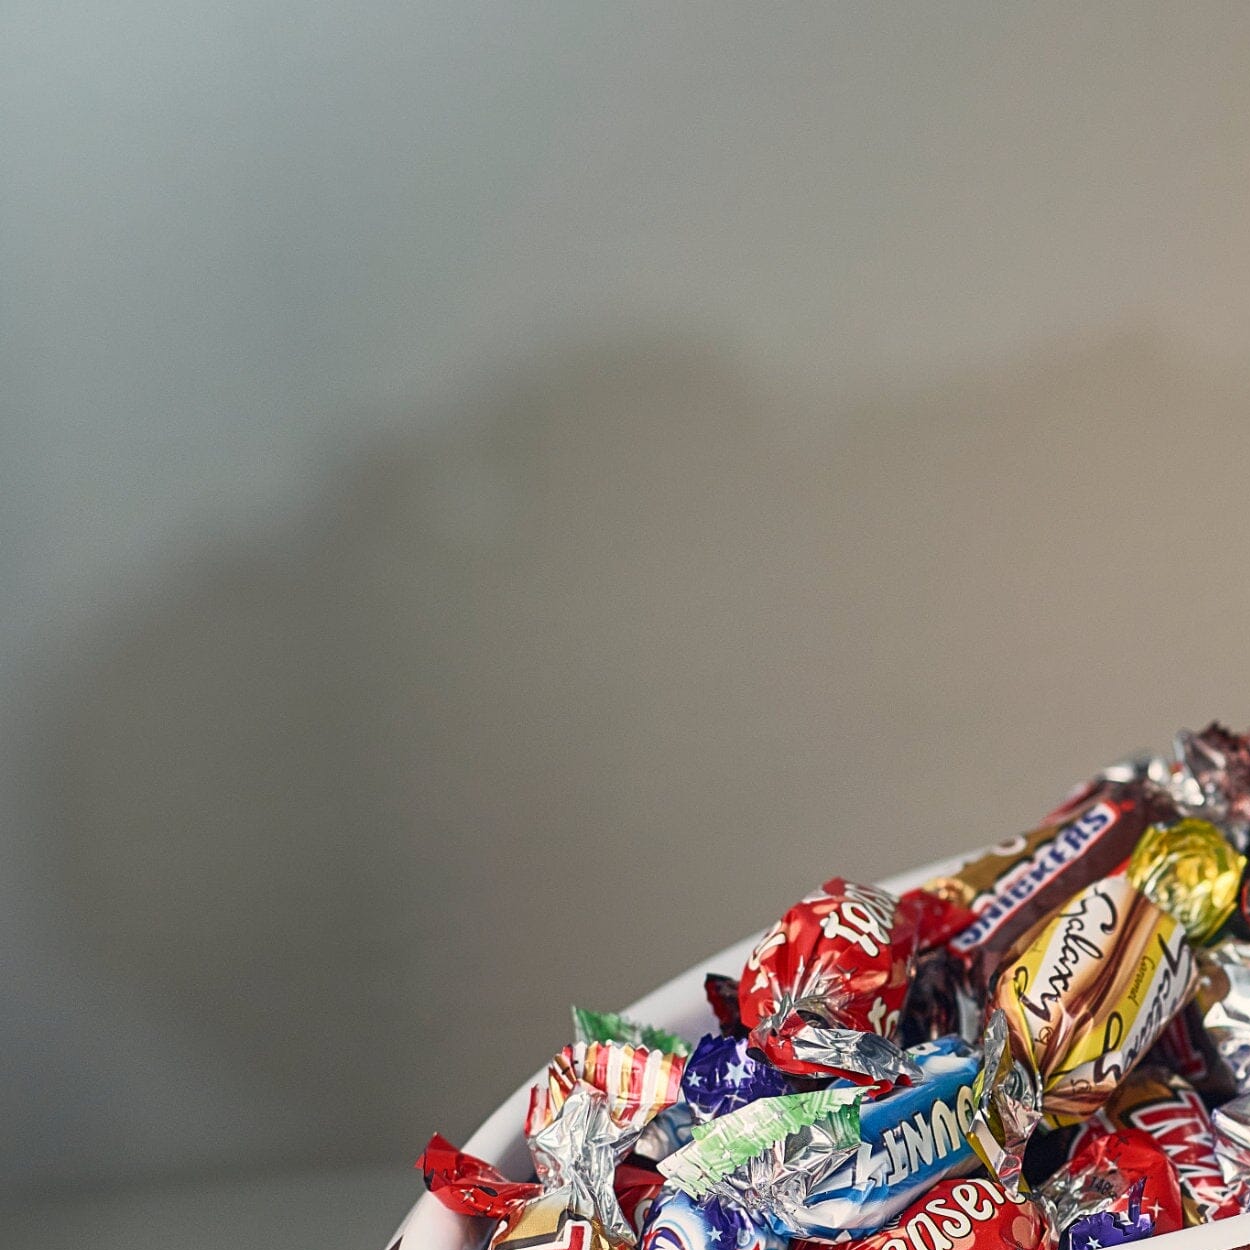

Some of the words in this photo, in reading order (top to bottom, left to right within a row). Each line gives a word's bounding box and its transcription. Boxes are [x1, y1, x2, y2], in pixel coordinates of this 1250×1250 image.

[962, 812, 1108, 945] SNICKERS
[1014, 887, 1118, 1023] Galaxy
[852, 1085, 984, 1189] OUNTY
